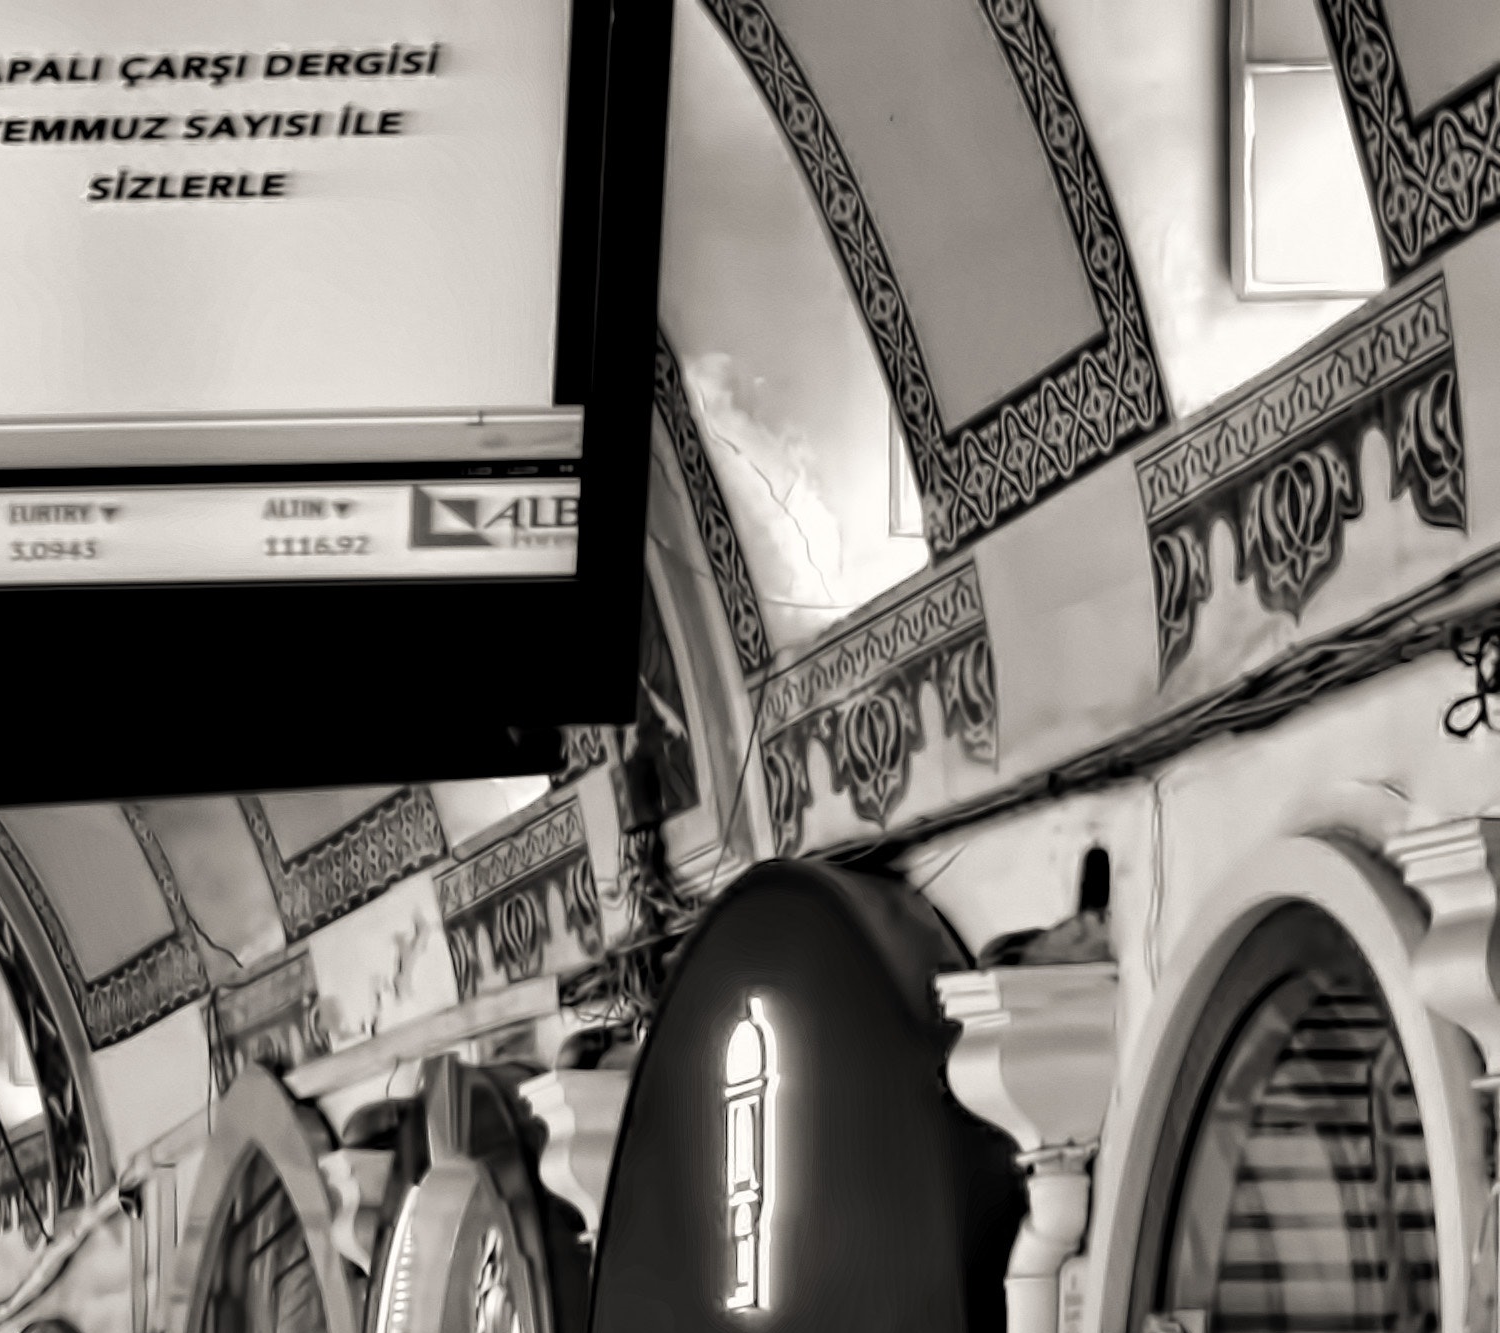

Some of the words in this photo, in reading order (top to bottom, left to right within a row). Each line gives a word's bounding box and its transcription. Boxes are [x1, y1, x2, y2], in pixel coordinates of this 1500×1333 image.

[119, 54, 247, 86] ÇARŞI
[263, 43, 441, 78] DERGİSİ
[183, 111, 322, 140] SAYISI
[337, 104, 404, 137] İLE
[88, 168, 286, 200] SİZLERLE
